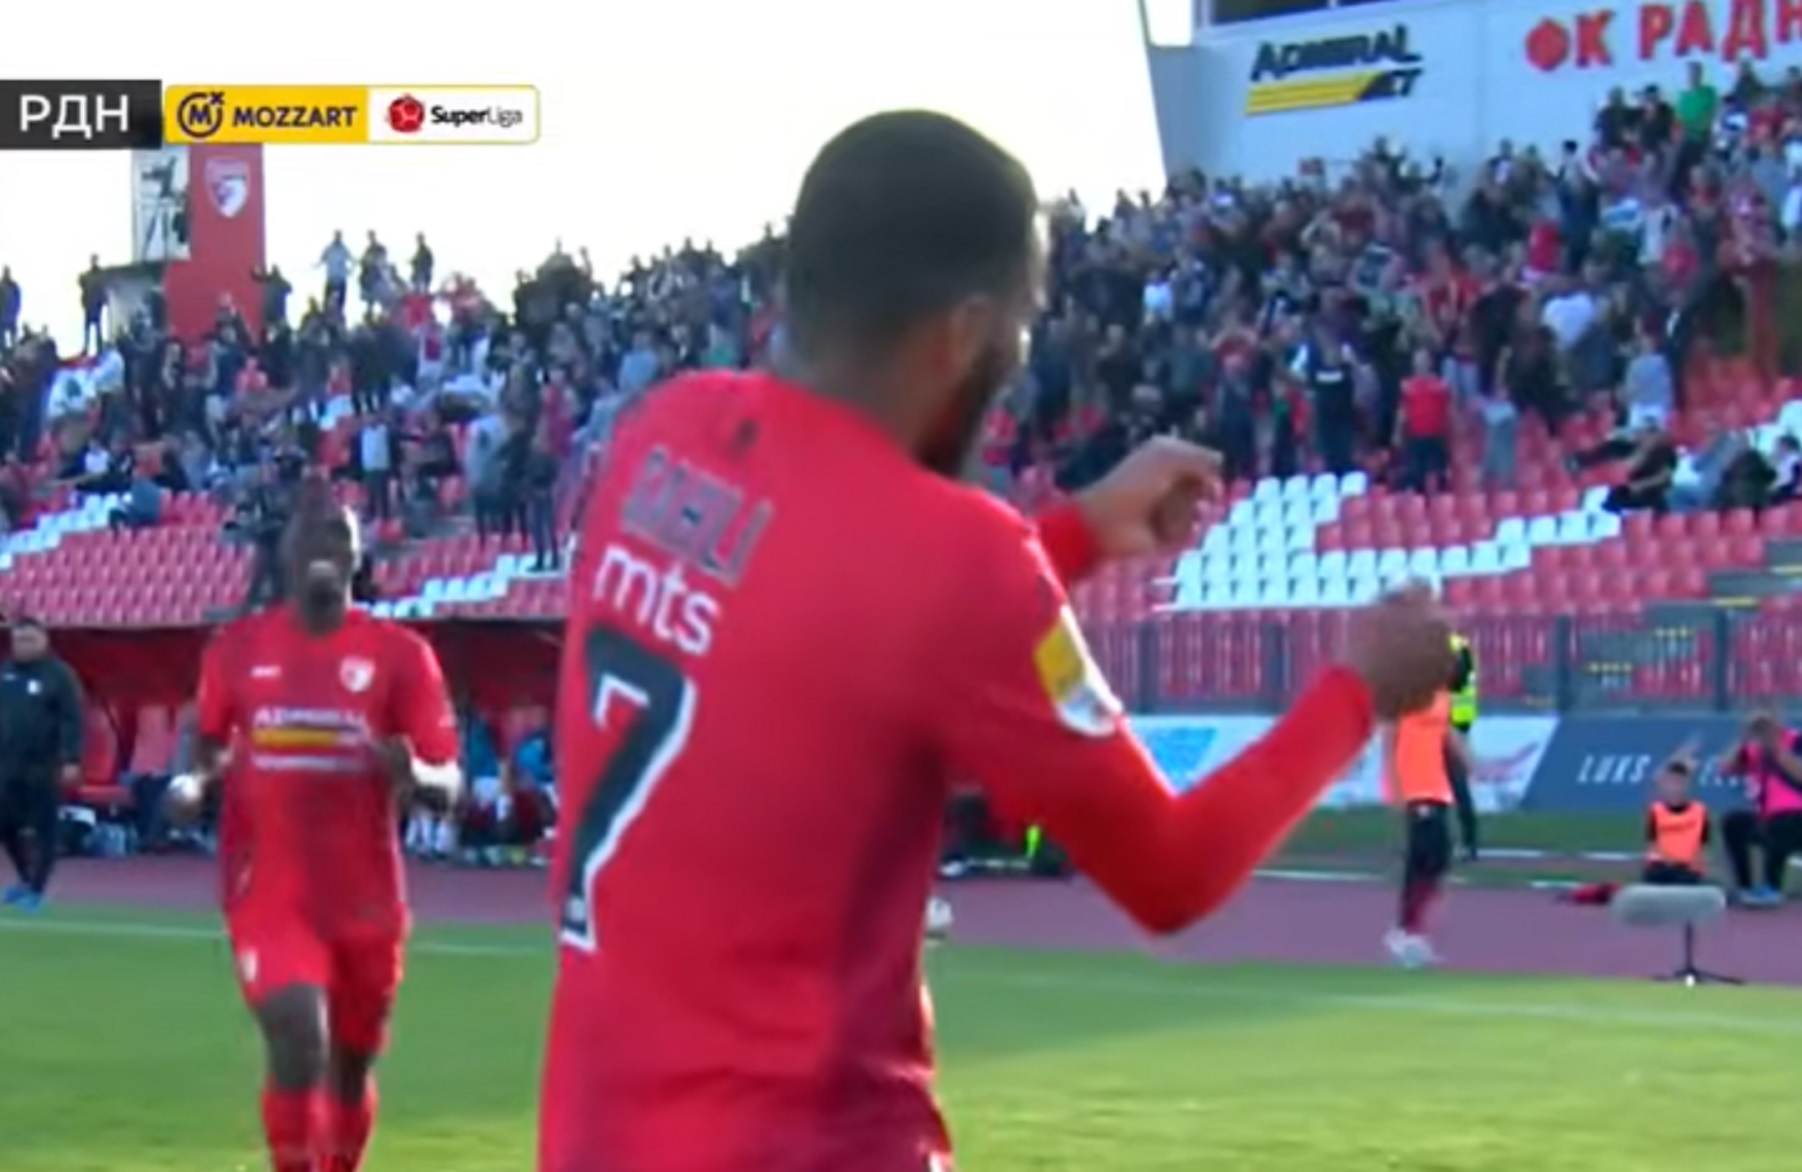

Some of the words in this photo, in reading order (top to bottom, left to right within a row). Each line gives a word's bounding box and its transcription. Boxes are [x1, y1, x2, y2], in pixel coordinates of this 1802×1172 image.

[1525, 10, 1615, 71] ФК
[593, 543, 722, 656] mts
[561, 620, 698, 953] 7
